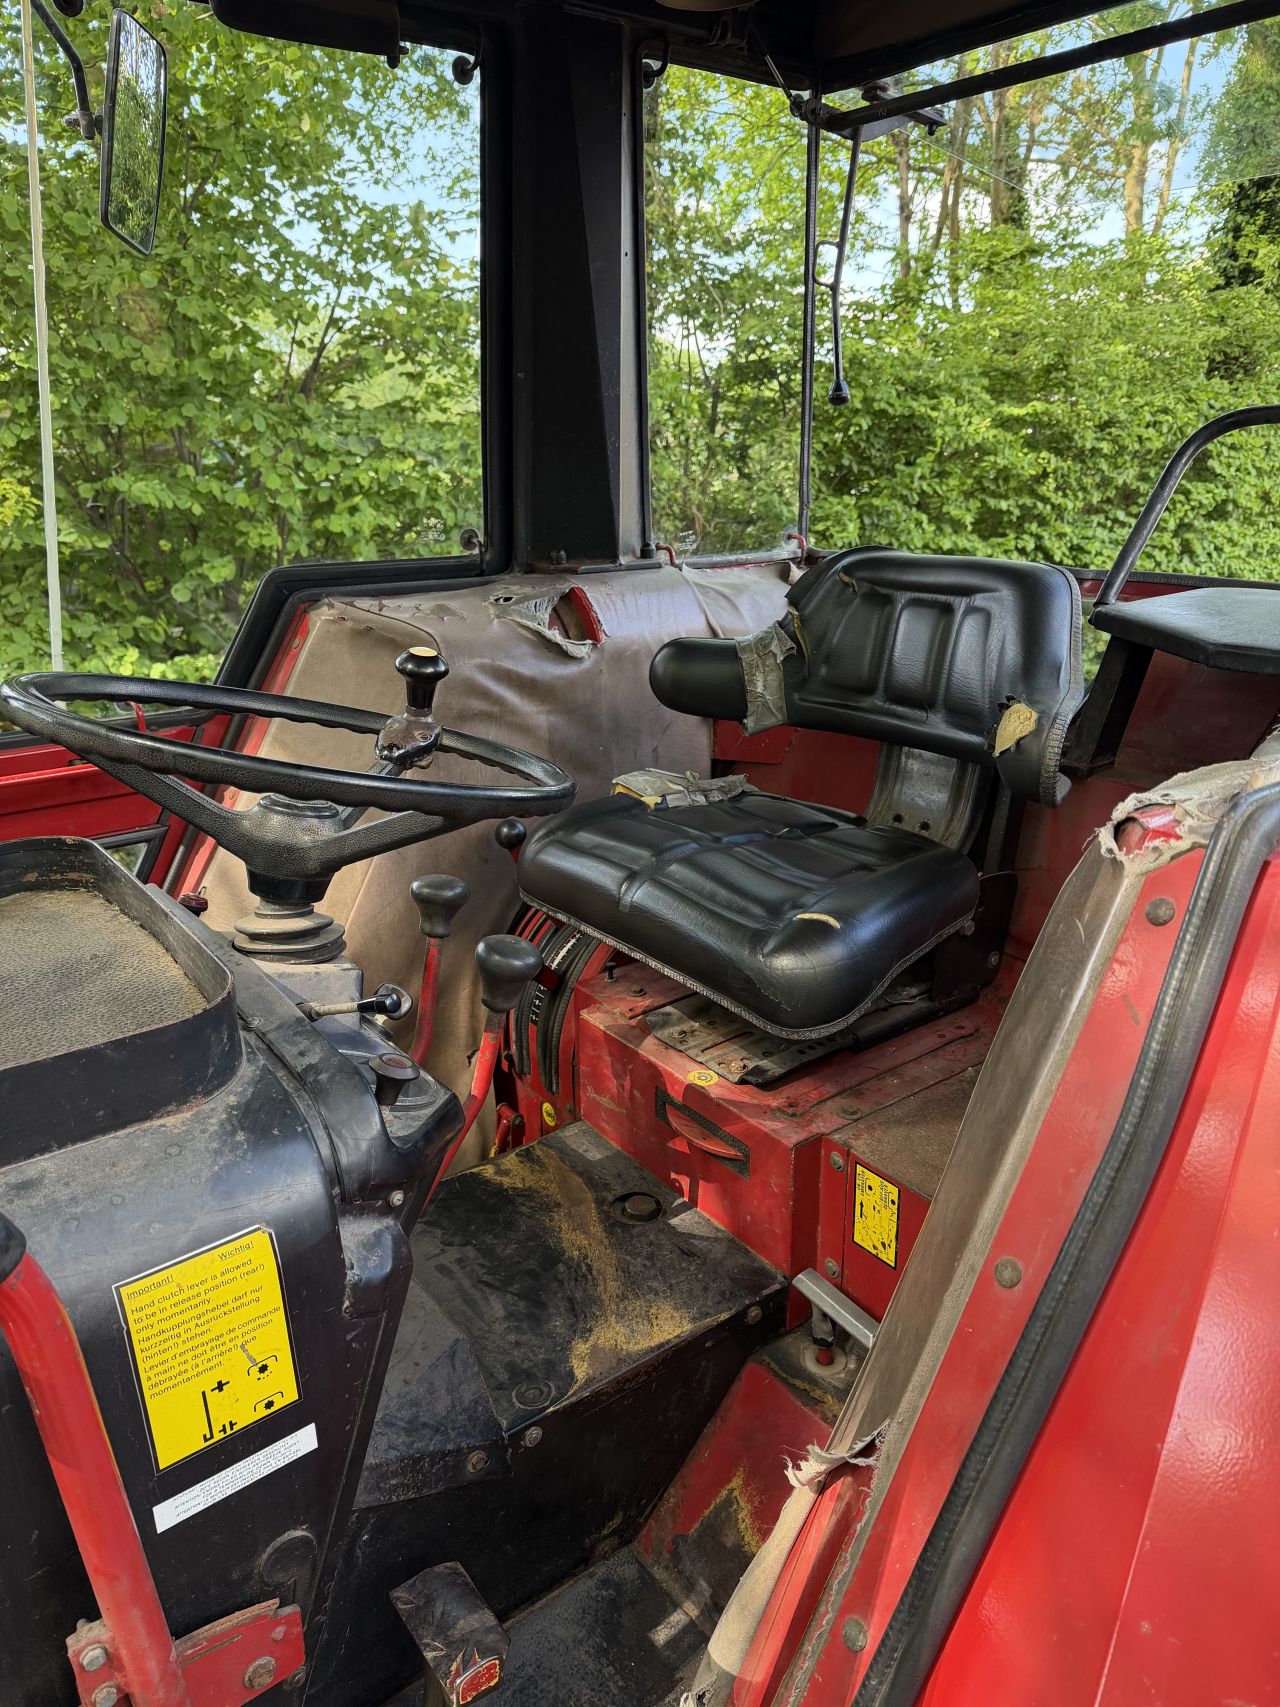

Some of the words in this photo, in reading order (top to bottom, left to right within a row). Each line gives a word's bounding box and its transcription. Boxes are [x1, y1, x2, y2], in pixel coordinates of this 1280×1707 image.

[217, 1240, 254, 1262] Wichtig!
[126, 1273, 174, 1300] Important!
[130, 1299, 155, 1315] Hand
[157, 1287, 184, 1303] clutch
[186, 1277, 208, 1291] lever
[219, 1257, 252, 1277] allowed
[133, 1316, 143, 1324] to
[144, 1311, 156, 1320] be
[158, 1306, 167, 1314] in
[169, 1291, 201, 1309] release
[203, 1275, 237, 1296] position
[135, 1321, 154, 1334] only
[137, 1299, 229, 1345] Handkupplungshebel
[231, 1290, 247, 1303] darf
[249, 1285, 262, 1295] nur
[139, 1331, 181, 1354] kurzzeitig
[194, 1295, 260, 1330] Ausrückstellung
[143, 1357, 169, 1373] Levier
[225, 1327, 236, 1335] de
[237, 1305, 280, 1329] commande
[141, 1341, 178, 1363] (hinten!)
[153, 1364, 175, 1378] main
[177, 1358, 188, 1367] ne
[190, 1349, 207, 1360] doit
[209, 1341, 226, 1352] être
[228, 1334, 239, 1343] en
[241, 1318, 272, 1338] position
[241, 1335, 256, 1347] que
